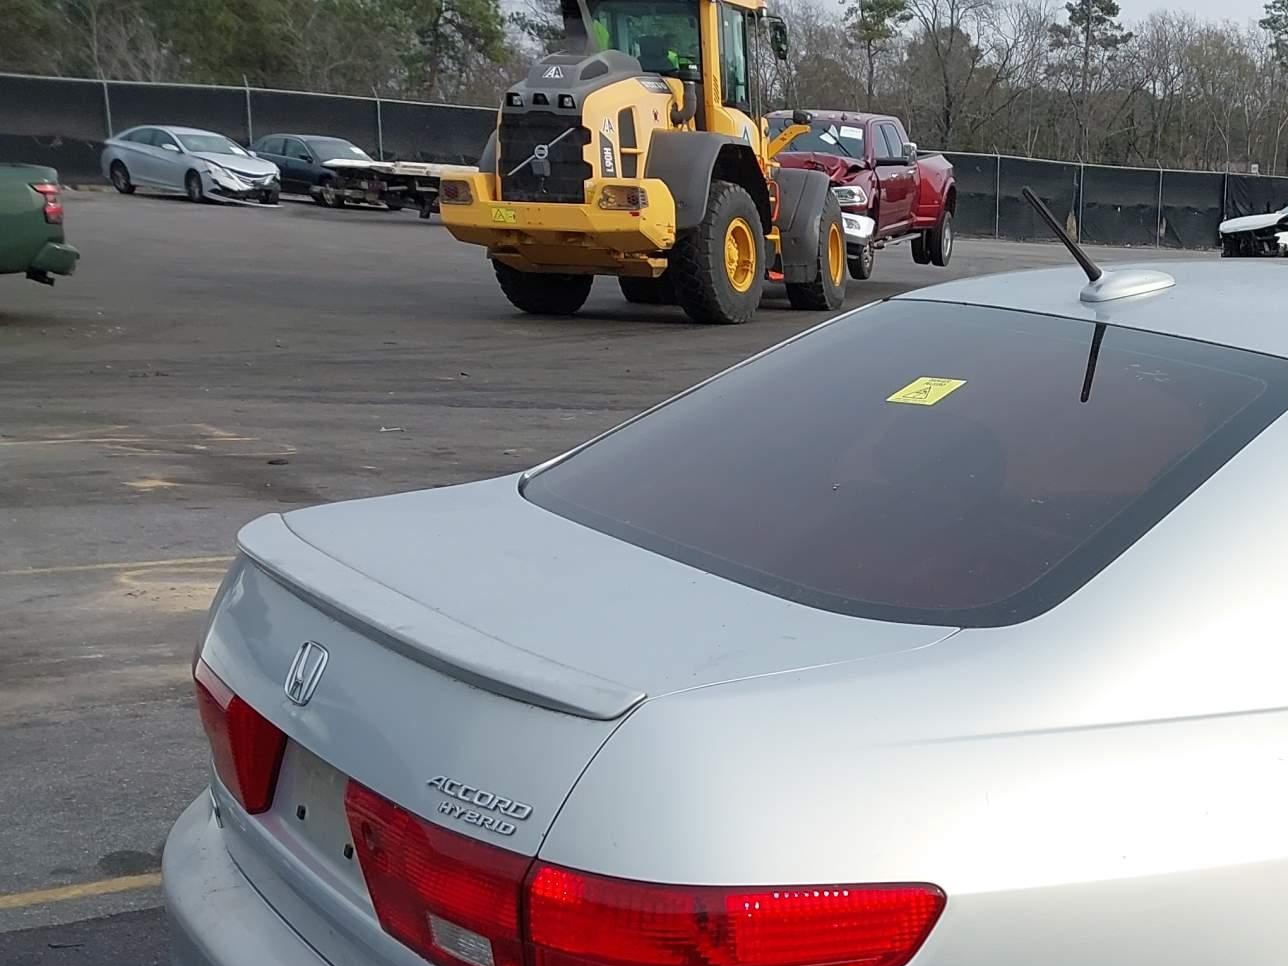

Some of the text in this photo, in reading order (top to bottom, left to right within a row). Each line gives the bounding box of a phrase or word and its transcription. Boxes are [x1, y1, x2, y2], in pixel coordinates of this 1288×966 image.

[602, 147, 614, 173] L90H
[425, 775, 534, 820] ACCORD
[438, 801, 516, 836] HYBRID
